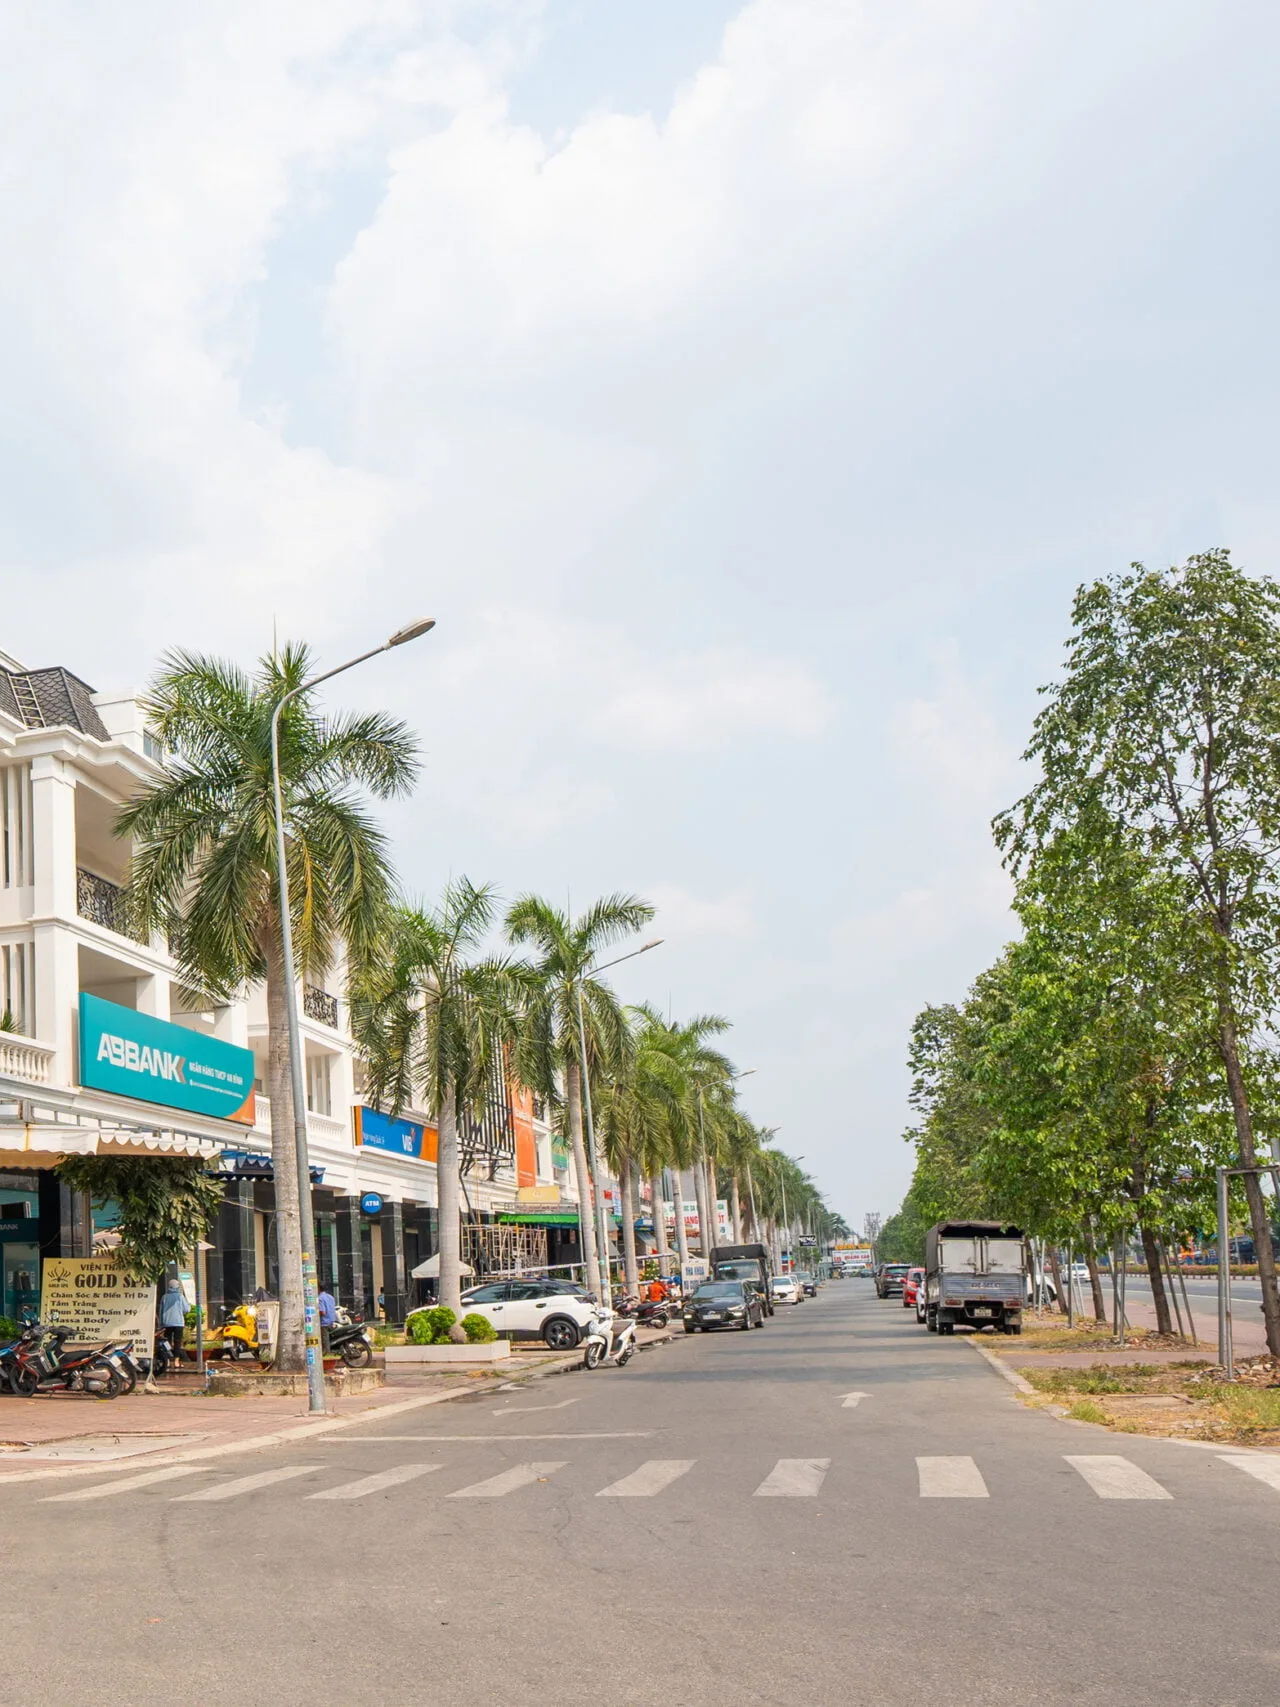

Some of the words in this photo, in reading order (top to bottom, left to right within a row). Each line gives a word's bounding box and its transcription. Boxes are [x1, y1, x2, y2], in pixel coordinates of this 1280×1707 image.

[97, 1032, 186, 1084] ABBANK
[402, 1134, 413, 1152] VIB
[80, 1262, 102, 1272] VIỆN
[74, 1274, 118, 1288] GOLD
